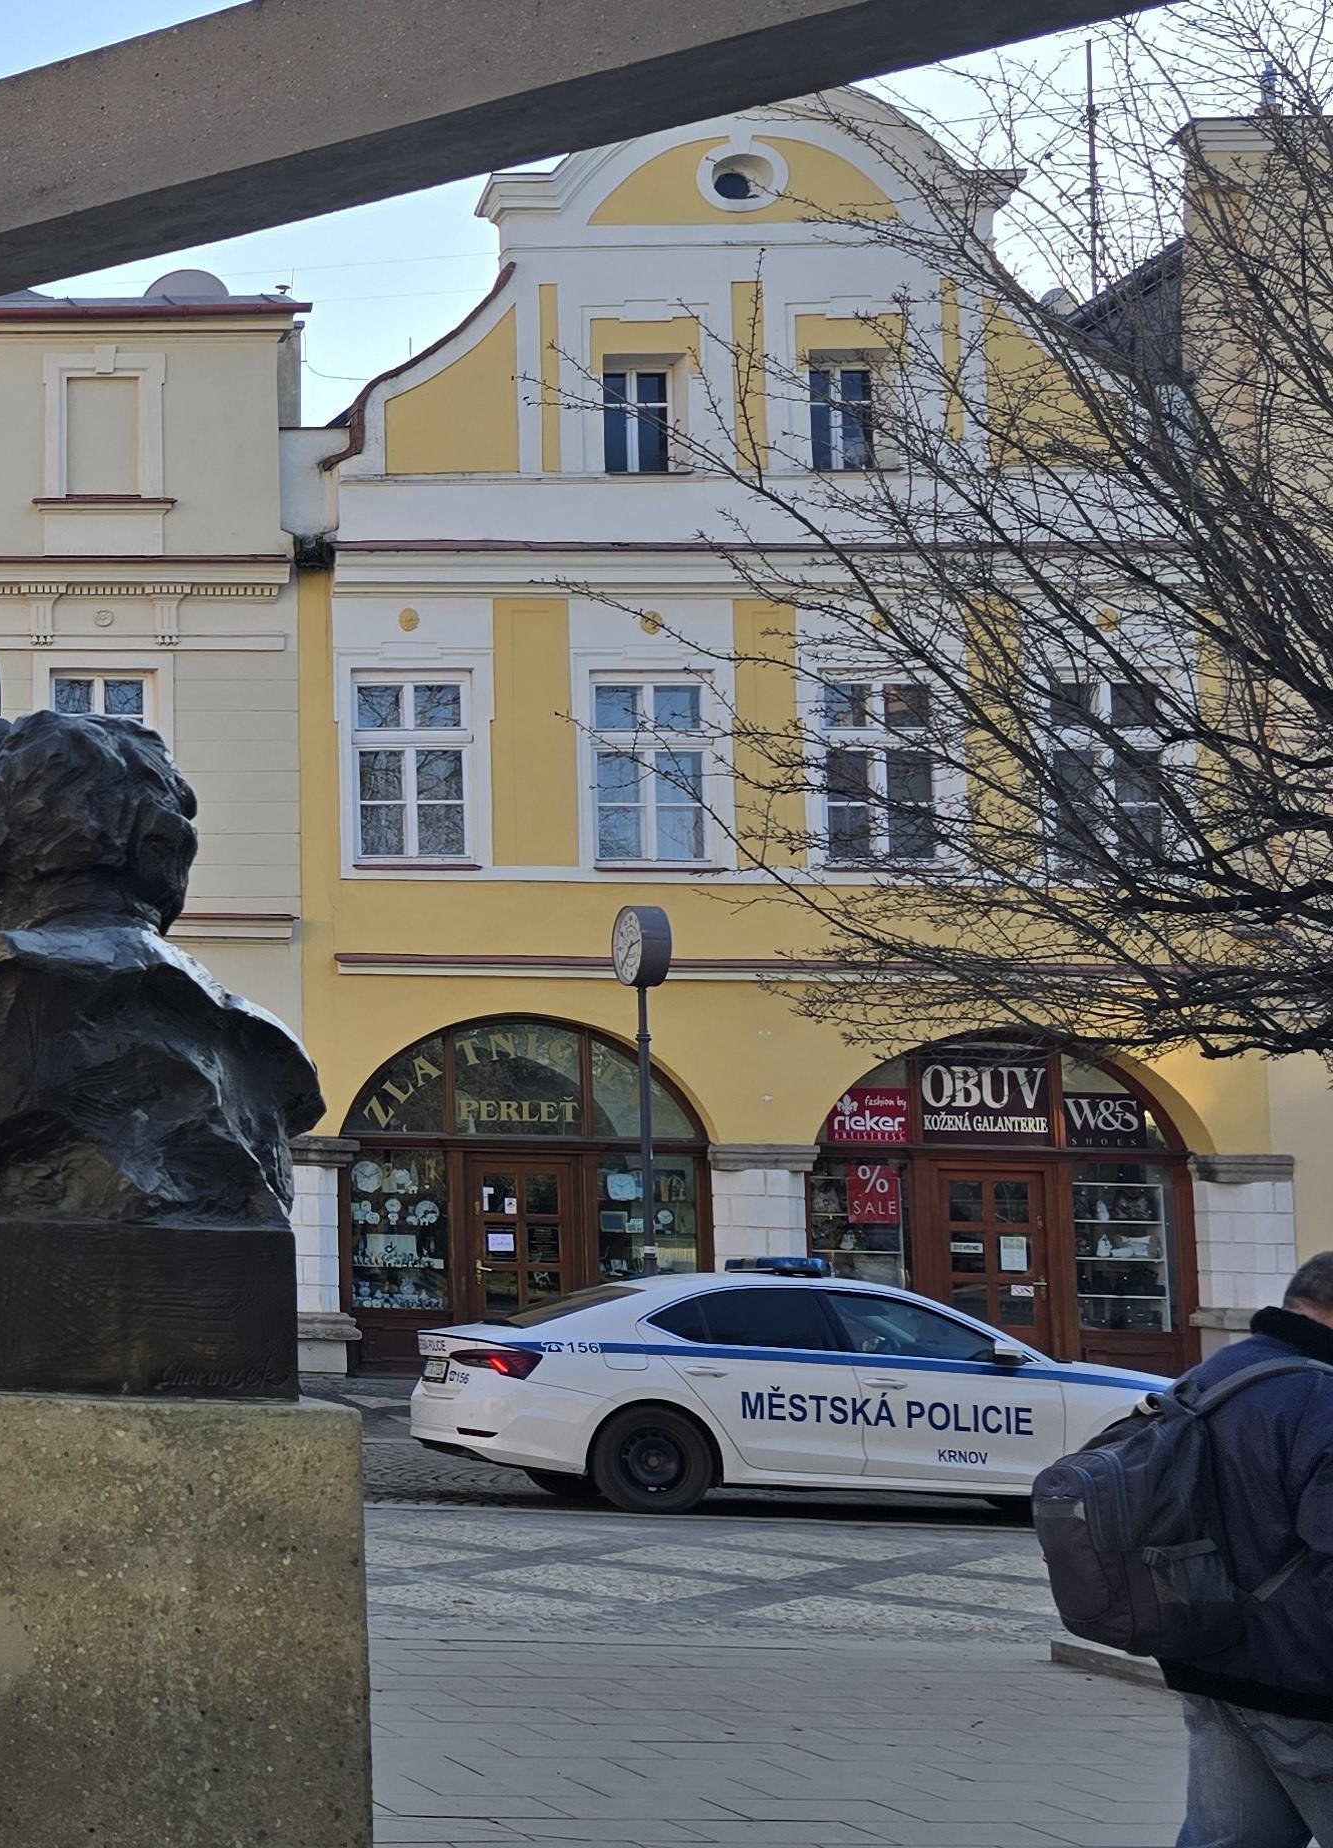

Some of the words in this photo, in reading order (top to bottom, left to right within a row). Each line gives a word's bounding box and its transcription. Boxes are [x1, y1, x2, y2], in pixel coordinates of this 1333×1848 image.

[922, 1065, 1046, 1109] OBUV
[459, 1096, 580, 1123] PERLEŤ
[896, 1095, 907, 1111] by
[834, 1110, 906, 1131] rieker
[923, 1111, 972, 1131] KOŽENÁ
[973, 1115, 1048, 1133] GALANTERIE
[1064, 1098, 1139, 1132] W&S
[858, 1165, 889, 1193] %
[853, 1200, 897, 1215] SALE
[567, 1342, 600, 1354] 156
[456, 1372, 470, 1384] 156
[741, 1385, 896, 1428] MĚSTSKÁ
[906, 1400, 1034, 1436] POLICIE
[938, 1449, 988, 1465] KRNOV
